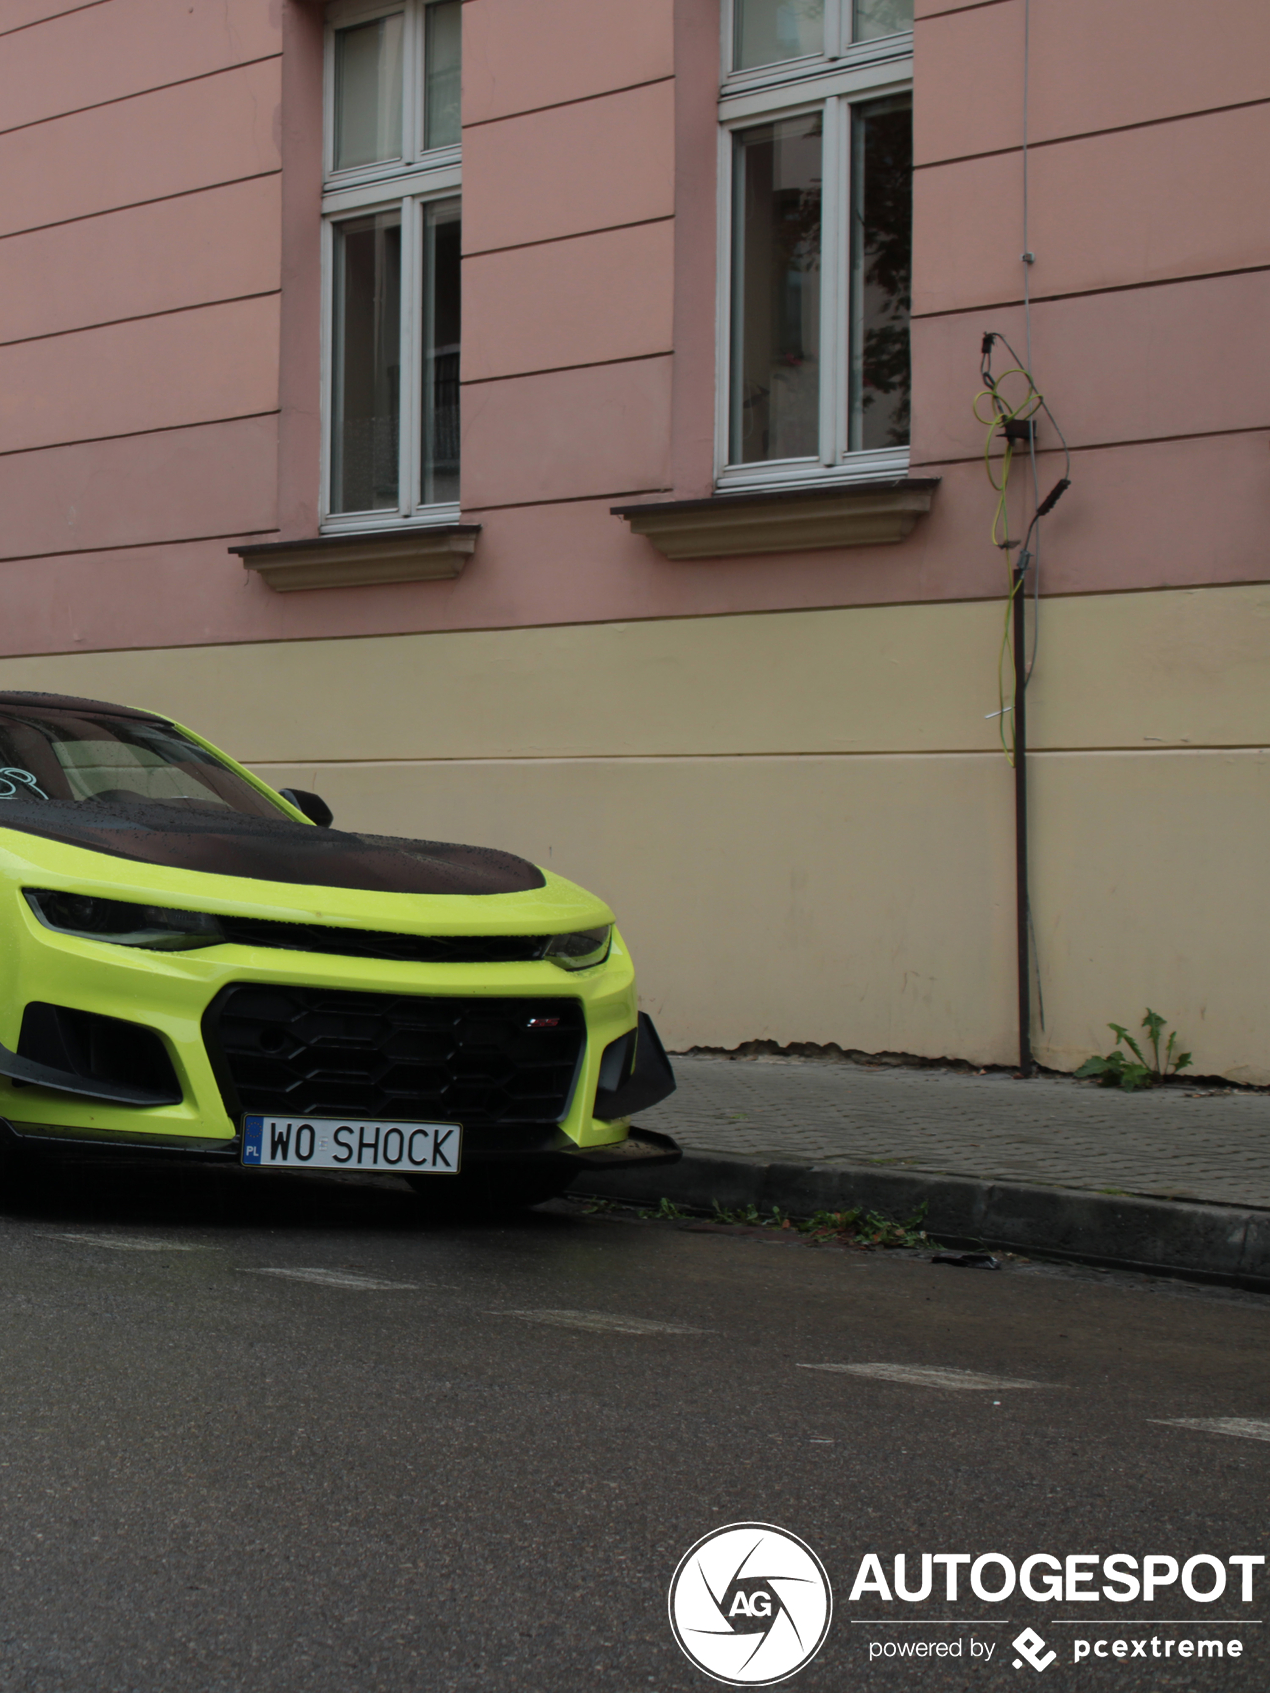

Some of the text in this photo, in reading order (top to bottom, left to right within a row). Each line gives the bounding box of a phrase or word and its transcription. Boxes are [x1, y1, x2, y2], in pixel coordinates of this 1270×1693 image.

[246, 1146, 259, 1157] PL
[270, 1122, 454, 1168] WO SHOCK
